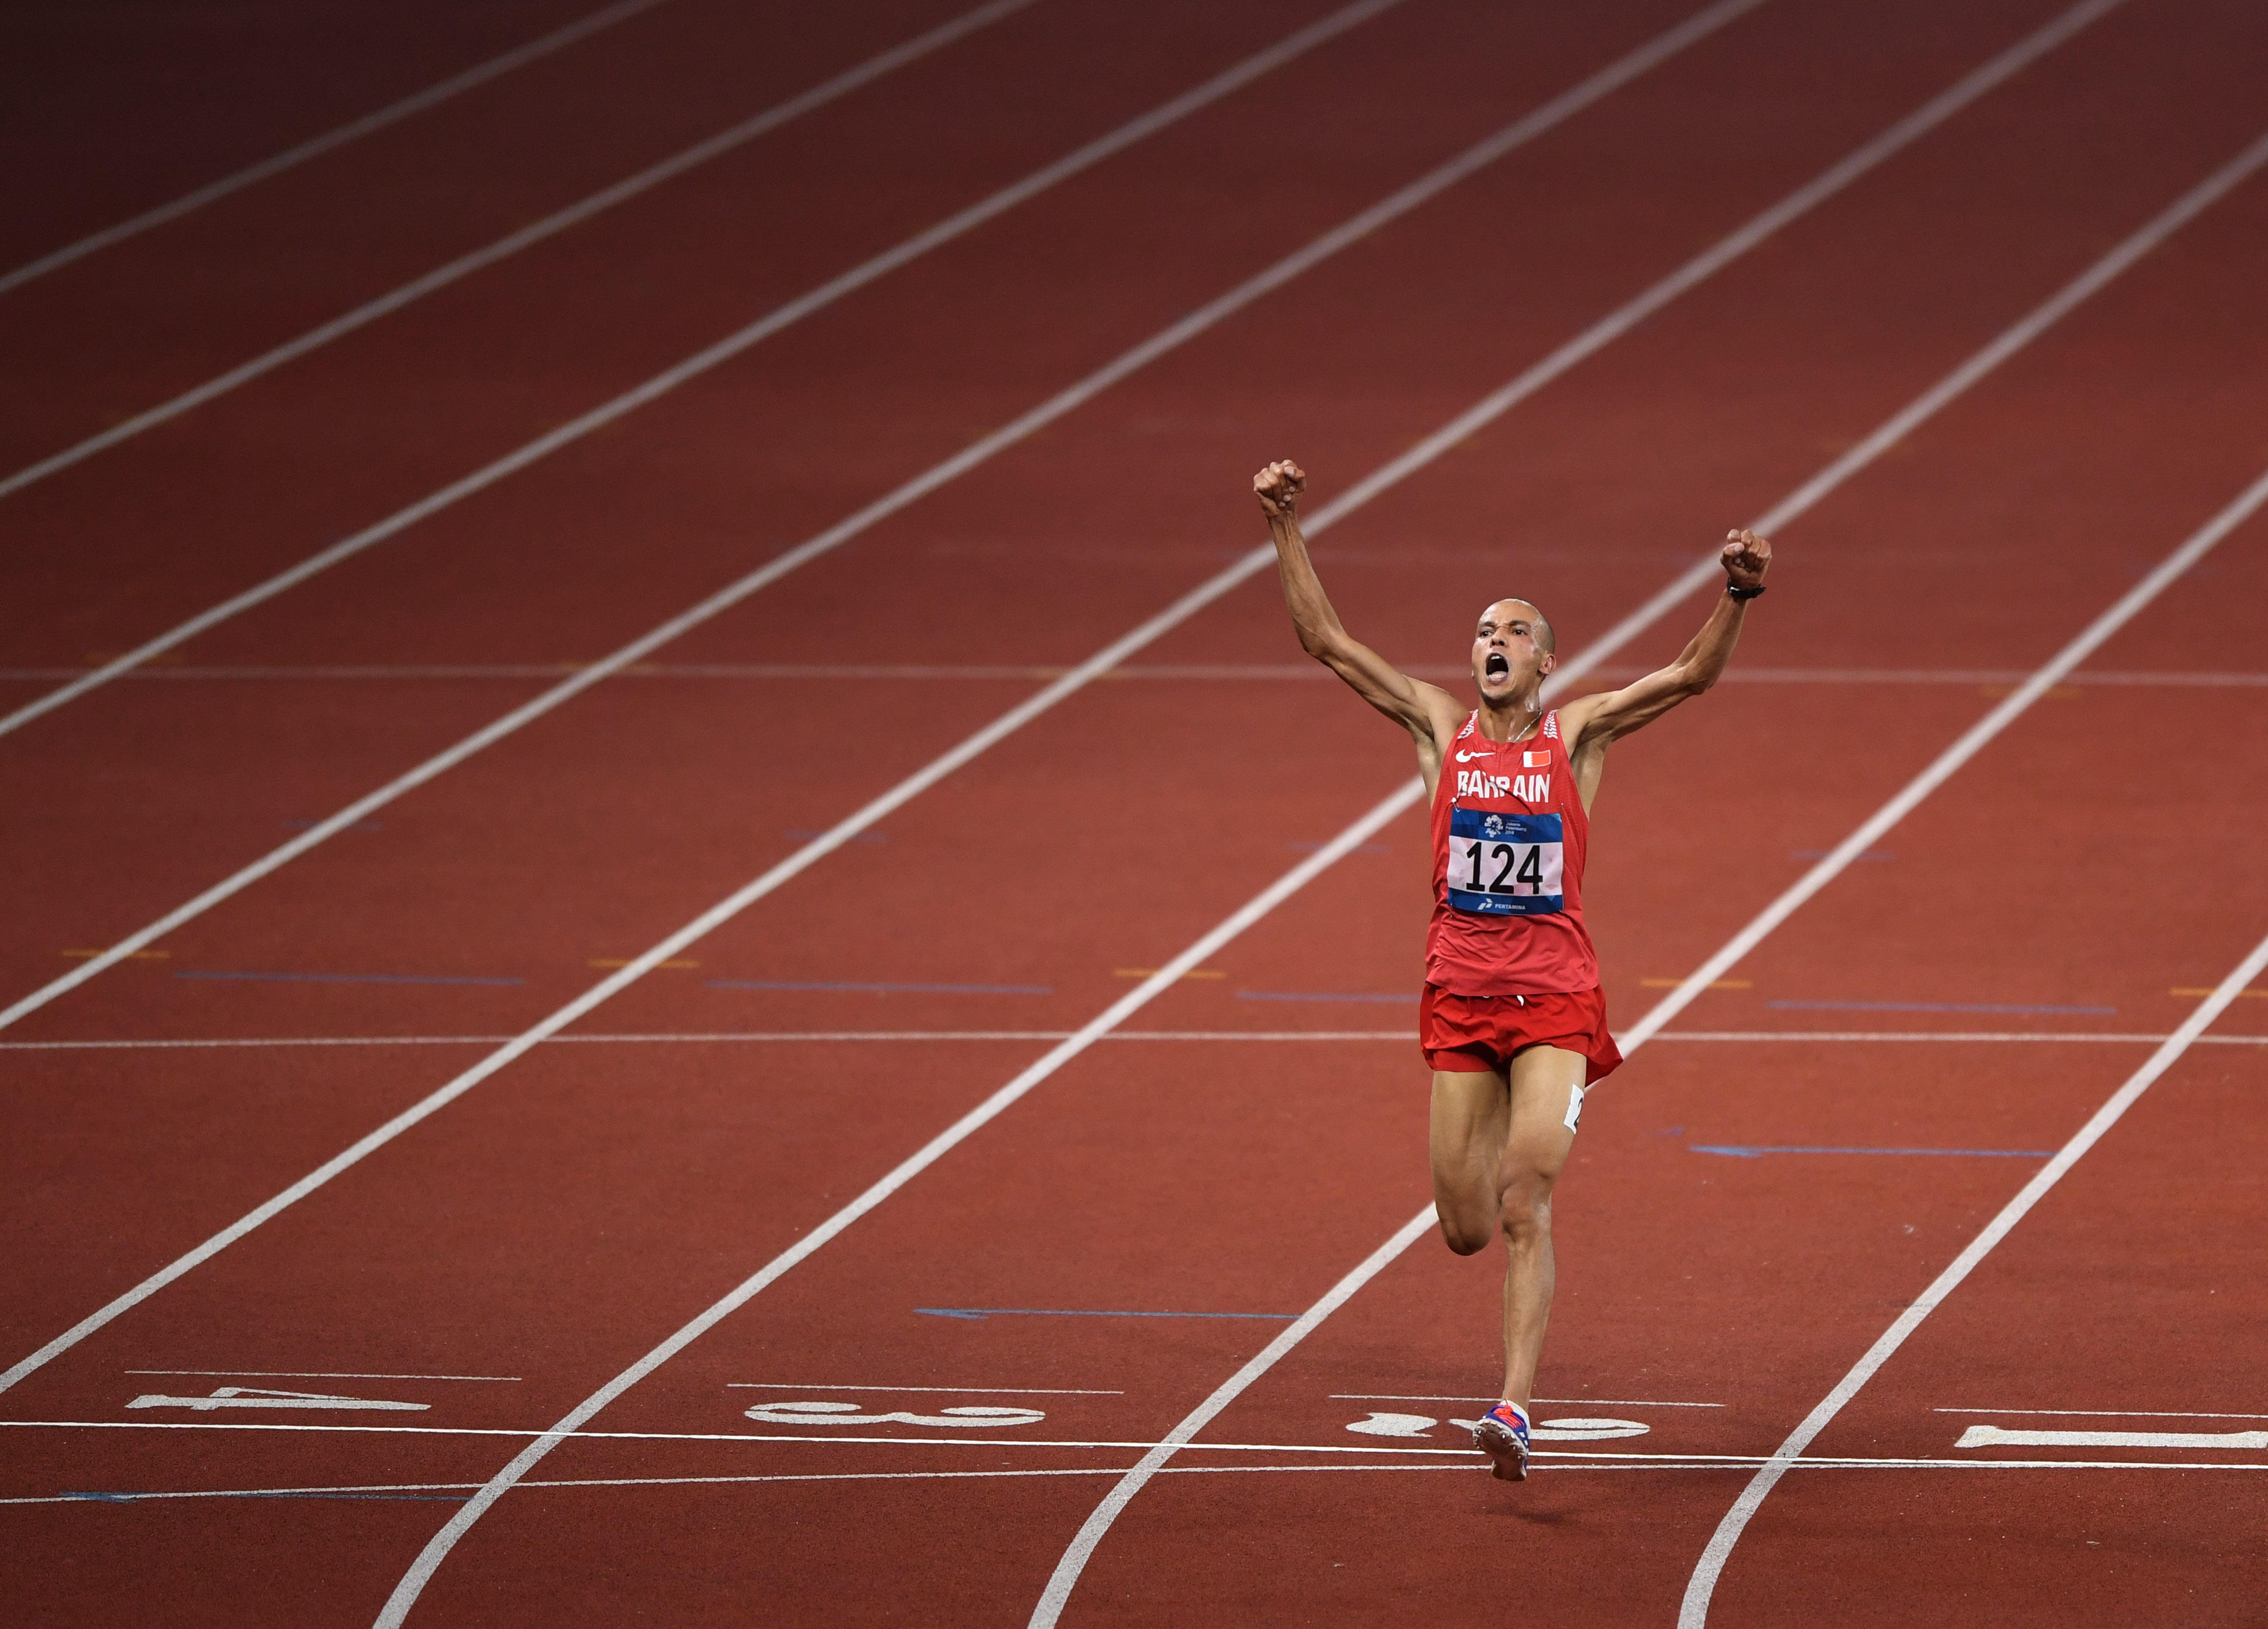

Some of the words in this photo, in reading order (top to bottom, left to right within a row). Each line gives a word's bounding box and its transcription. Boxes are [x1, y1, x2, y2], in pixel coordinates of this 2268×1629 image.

[1458, 770, 1551, 803] BAHRAIN
[1466, 842, 1543, 894] 124
[124, 1387, 432, 1411] 4
[744, 1401, 1046, 1427] 3
[1954, 1425, 2268, 1449] 1
